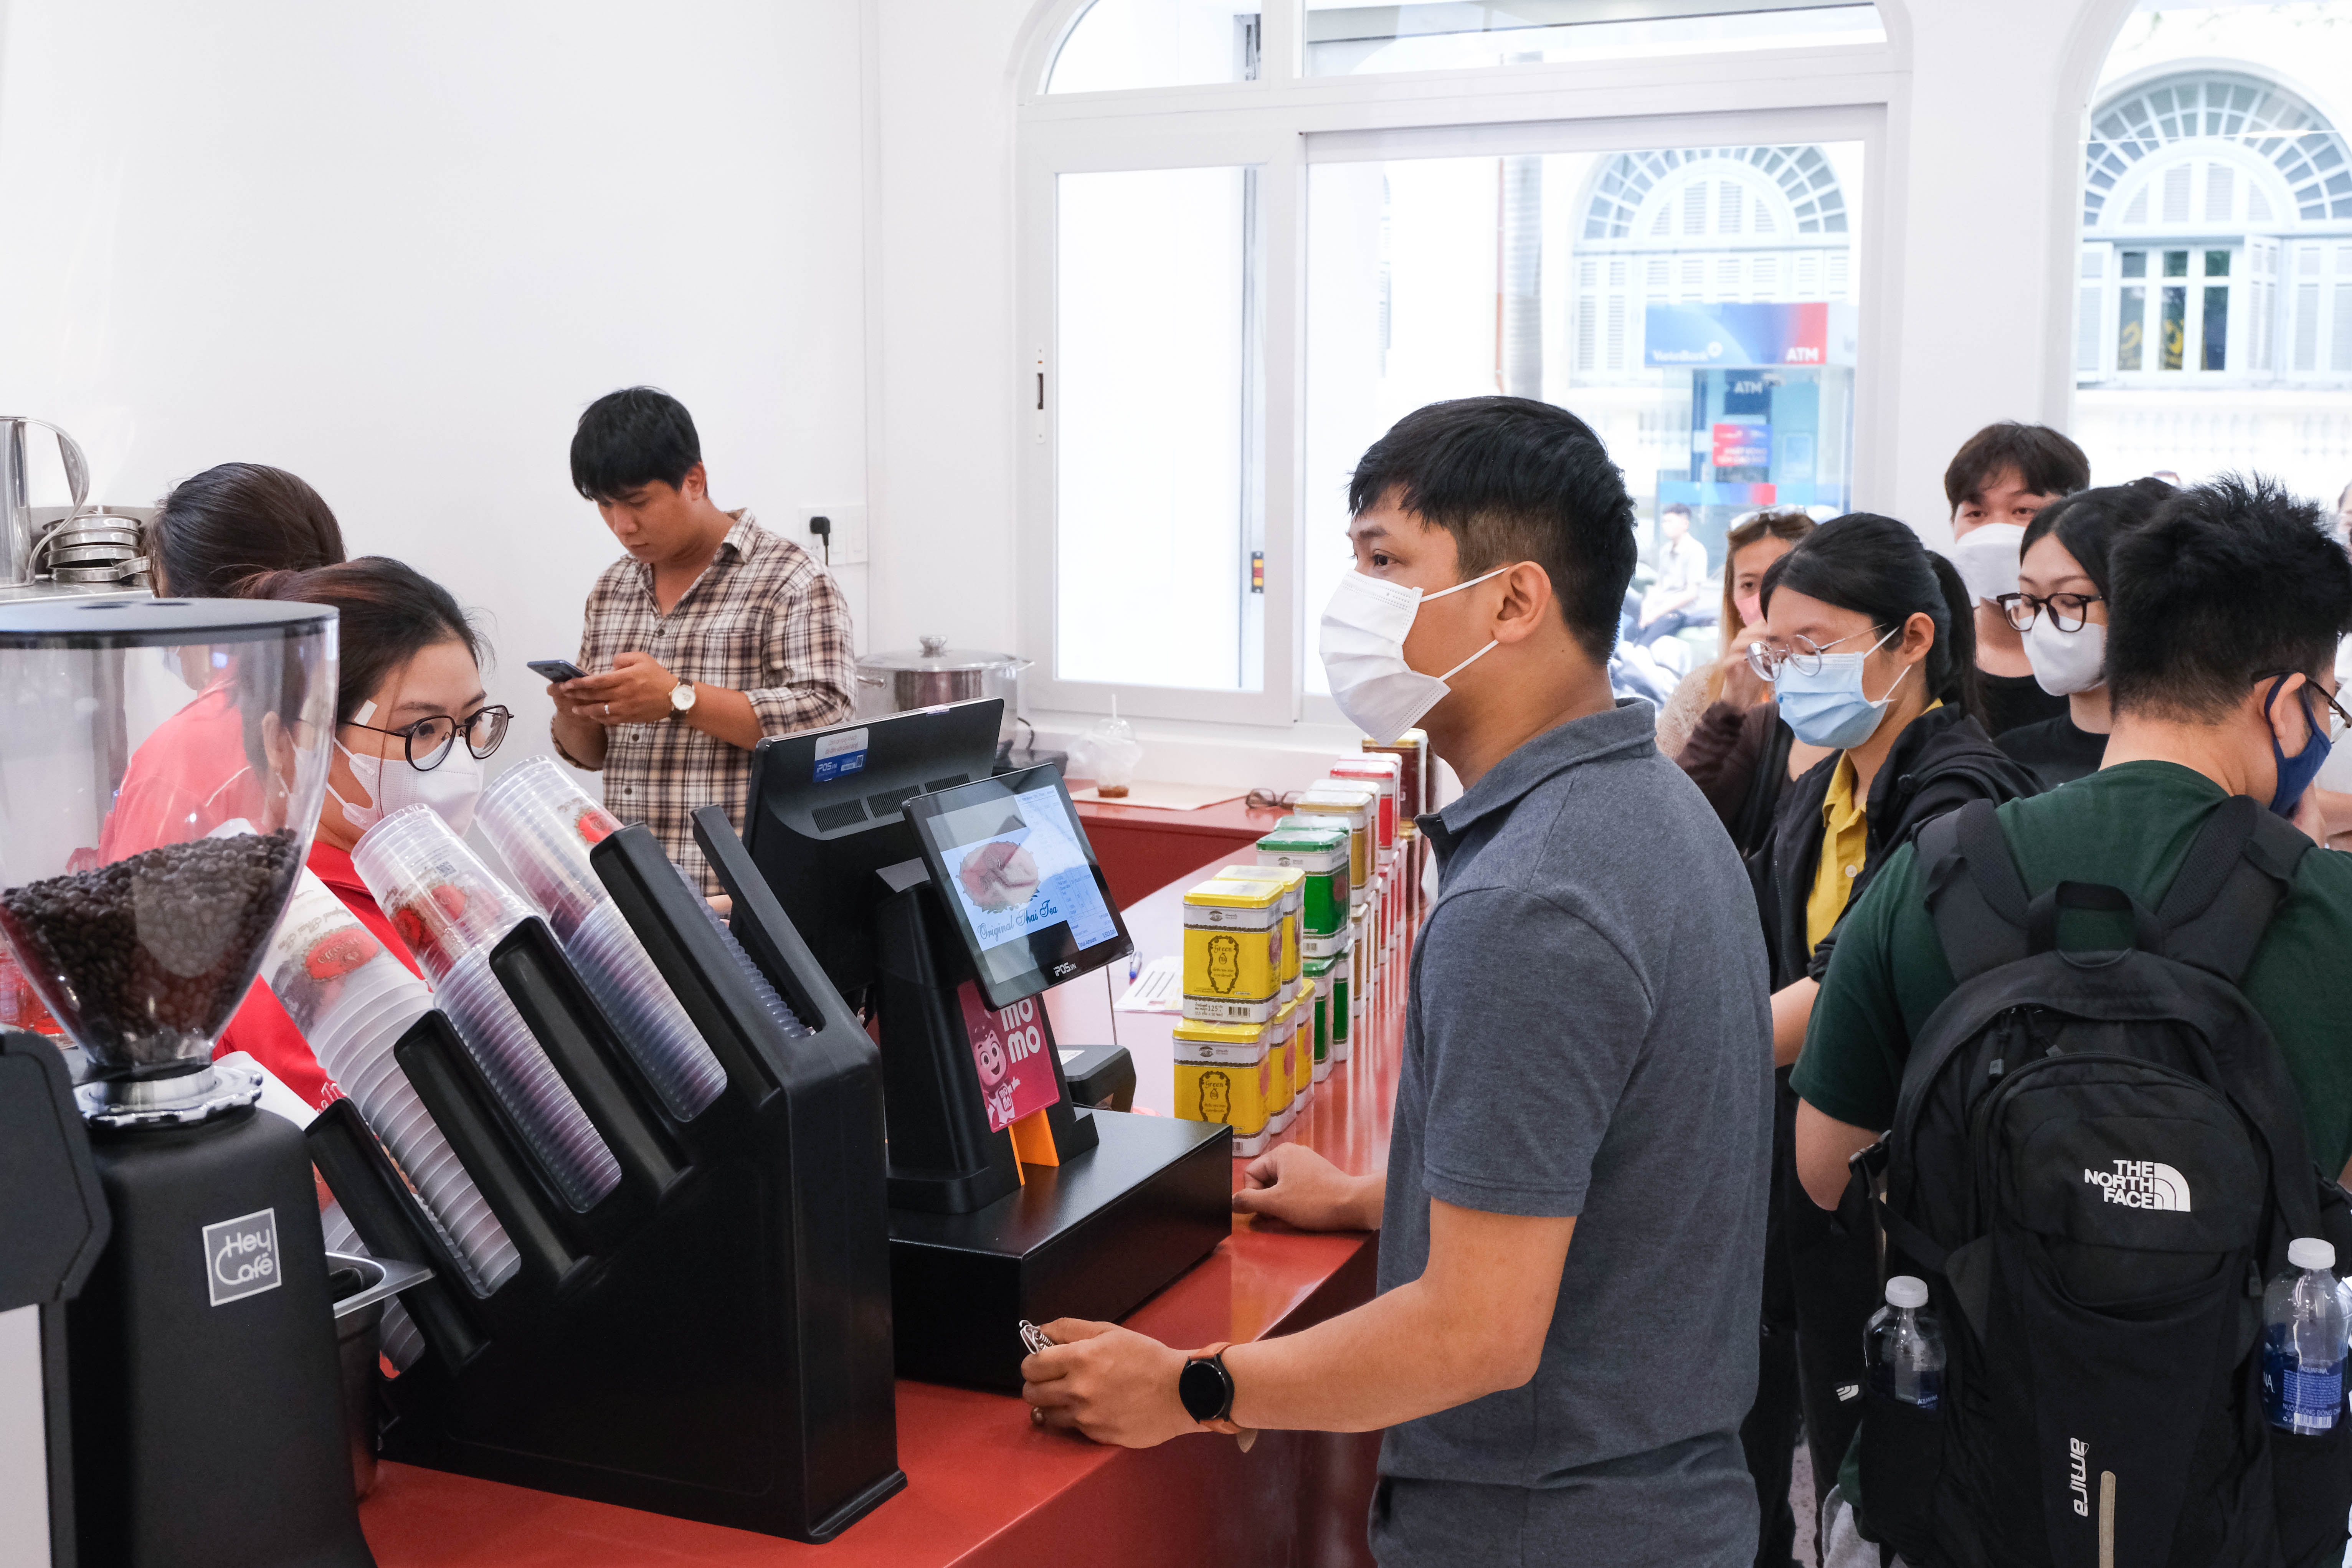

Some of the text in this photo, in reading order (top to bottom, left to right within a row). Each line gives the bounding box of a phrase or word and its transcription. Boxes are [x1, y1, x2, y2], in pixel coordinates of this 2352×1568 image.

[1786, 347, 1818, 362] ATM
[1734, 381, 1763, 394] ATM
[977, 899, 1058, 942] Original Thai Tea
[1000, 998, 1033, 1032] mo
[1008, 1025, 1041, 1064] mo
[1205, 1081, 1224, 1089] Green
[2084, 1168, 2154, 1193] NORTH
[2113, 1160, 2154, 1178] THE
[2104, 1186, 2154, 1209] FACE
[225, 1229, 272, 1258] Hey
[215, 1252, 273, 1285] Café
